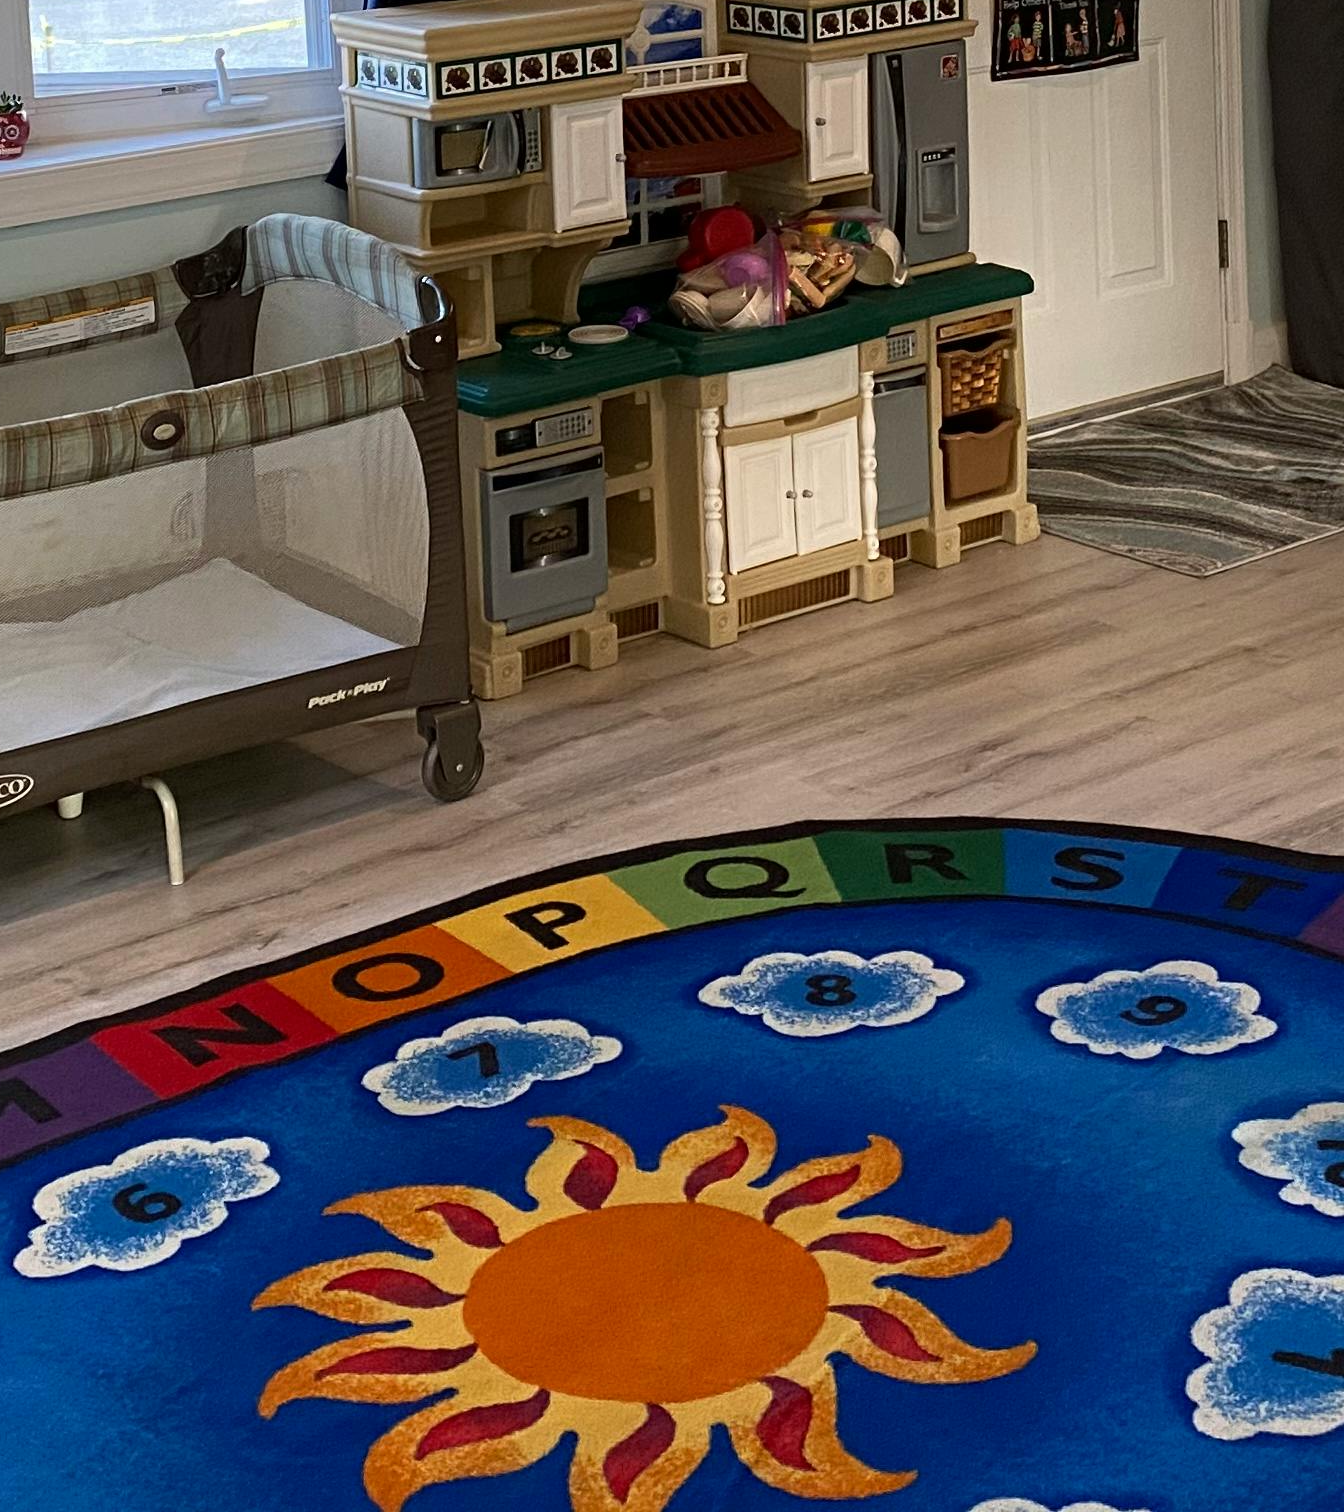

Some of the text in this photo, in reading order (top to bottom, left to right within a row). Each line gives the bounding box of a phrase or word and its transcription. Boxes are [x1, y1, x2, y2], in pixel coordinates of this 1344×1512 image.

[1003, 0, 1020, 10] Help
[308, 689, 347, 709] Pack
[353, 679, 387, 696] Play
[682, 856, 807, 900] Q
[883, 842, 970, 887] R
[1047, 846, 1127, 891] S
[1217, 867, 1306, 913] T
[503, 901, 588, 950] P
[331, 951, 446, 1003] O
[805, 974, 857, 1006] 8
[164, 1003, 290, 1068] N
[442, 1041, 504, 1082] 7
[112, 1181, 183, 1224] 6
